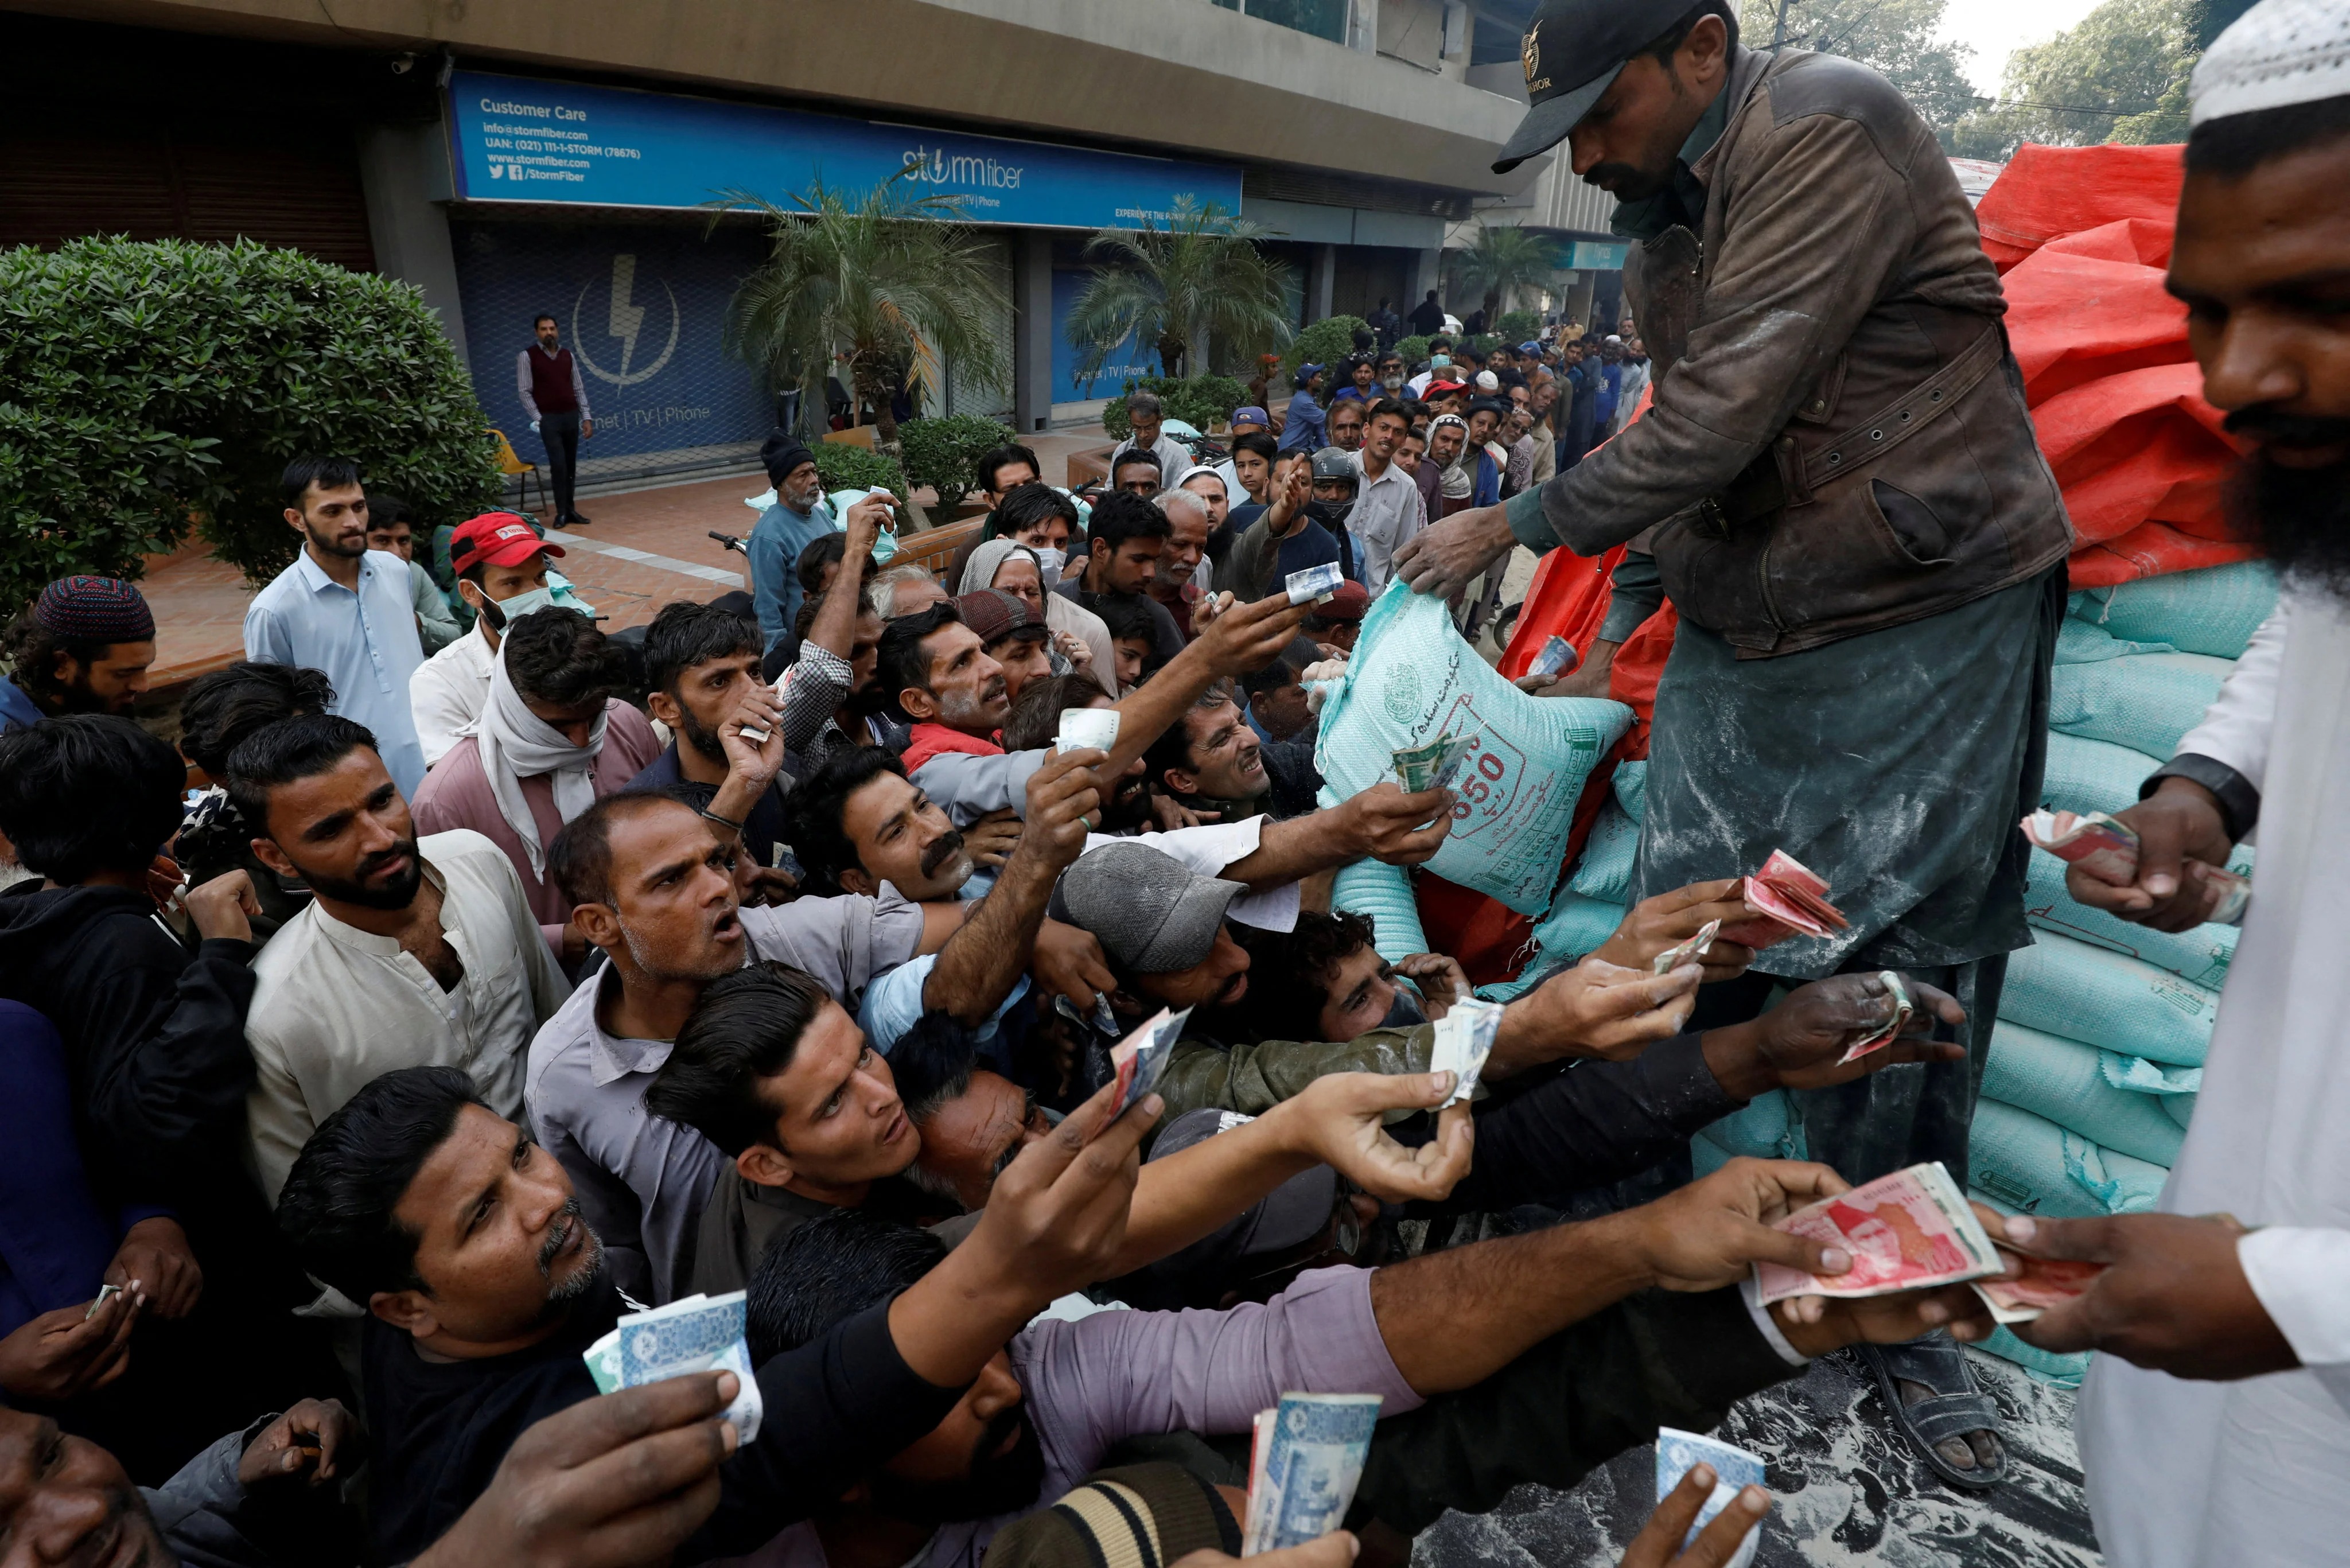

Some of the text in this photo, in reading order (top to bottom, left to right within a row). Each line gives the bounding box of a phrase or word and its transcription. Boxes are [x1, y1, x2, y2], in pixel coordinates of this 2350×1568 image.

[480, 98, 586, 121] Customer Care
[483, 122, 588, 141] info@stormfiber.com
[485, 137, 641, 160] UAN: (021) 111-1-STORM (78676)
[487, 154, 590, 168] www.stormfiber.com
[965, 196, 975, 204] TV
[979, 196, 1000, 207] Phone
[1153, 211, 1165, 220] THE
[1108, 367, 1119, 377] TV
[1125, 365, 1146, 376] Phone
[632, 410, 652, 425] TV
[666, 406, 710, 422] Phone
[1454, 752, 1505, 820] 650
